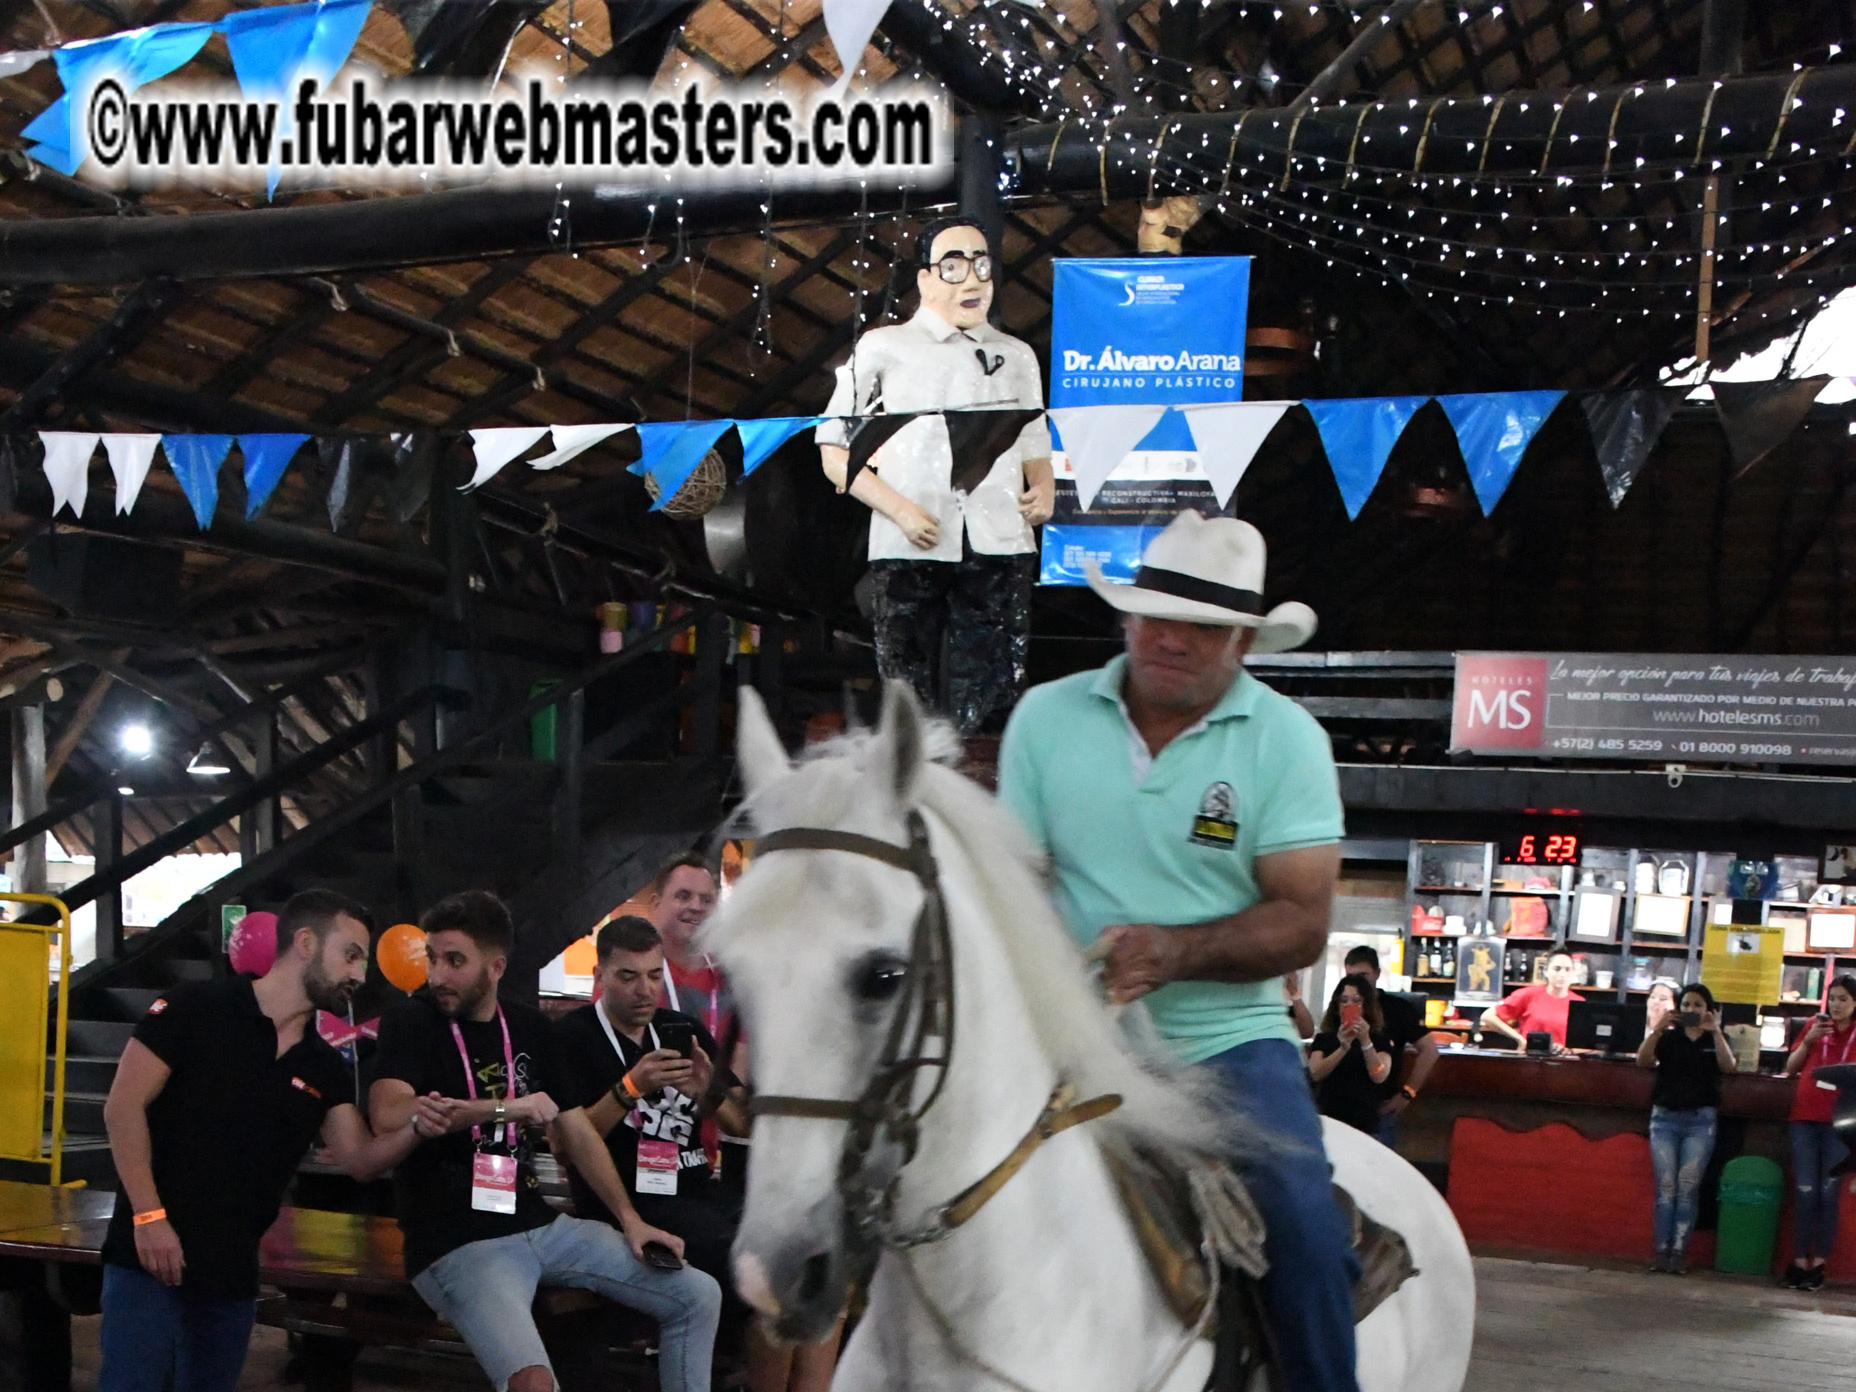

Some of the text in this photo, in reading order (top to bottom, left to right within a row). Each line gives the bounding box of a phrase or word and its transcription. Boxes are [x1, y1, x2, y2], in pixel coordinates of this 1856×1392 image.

[1063, 345, 1241, 371] Dr. Álvaro Arana
[1062, 375, 1236, 389] CIRUJANO PLÁSTICO
[1471, 676, 1533, 686] HOTELES
[1550, 659, 1568, 680] La
[1571, 665, 1616, 686] mejor
[1617, 665, 1668, 686] opción
[1663, 670, 1706, 688] para
[1736, 668, 1780, 689] viajes
[1784, 667, 1805, 682] de
[1567, 691, 1600, 701] MEJOR
[1602, 692, 1640, 702] PRECIO
[1642, 693, 1715, 704] GARANTIZADO
[1717, 694, 1740, 704] POR
[1742, 695, 1777, 705] MEDIO
[1779, 696, 1794, 705] DE
[1796, 697, 1845, 707] NUESTRA
[1467, 689, 1532, 730] MS
[1653, 708, 1820, 726] www.hotelesms.com
[1552, 737, 1663, 751] +57(2) 485 5259
[1679, 741, 1792, 755] 01 8000 910098
[1544, 834, 1577, 858] 23
